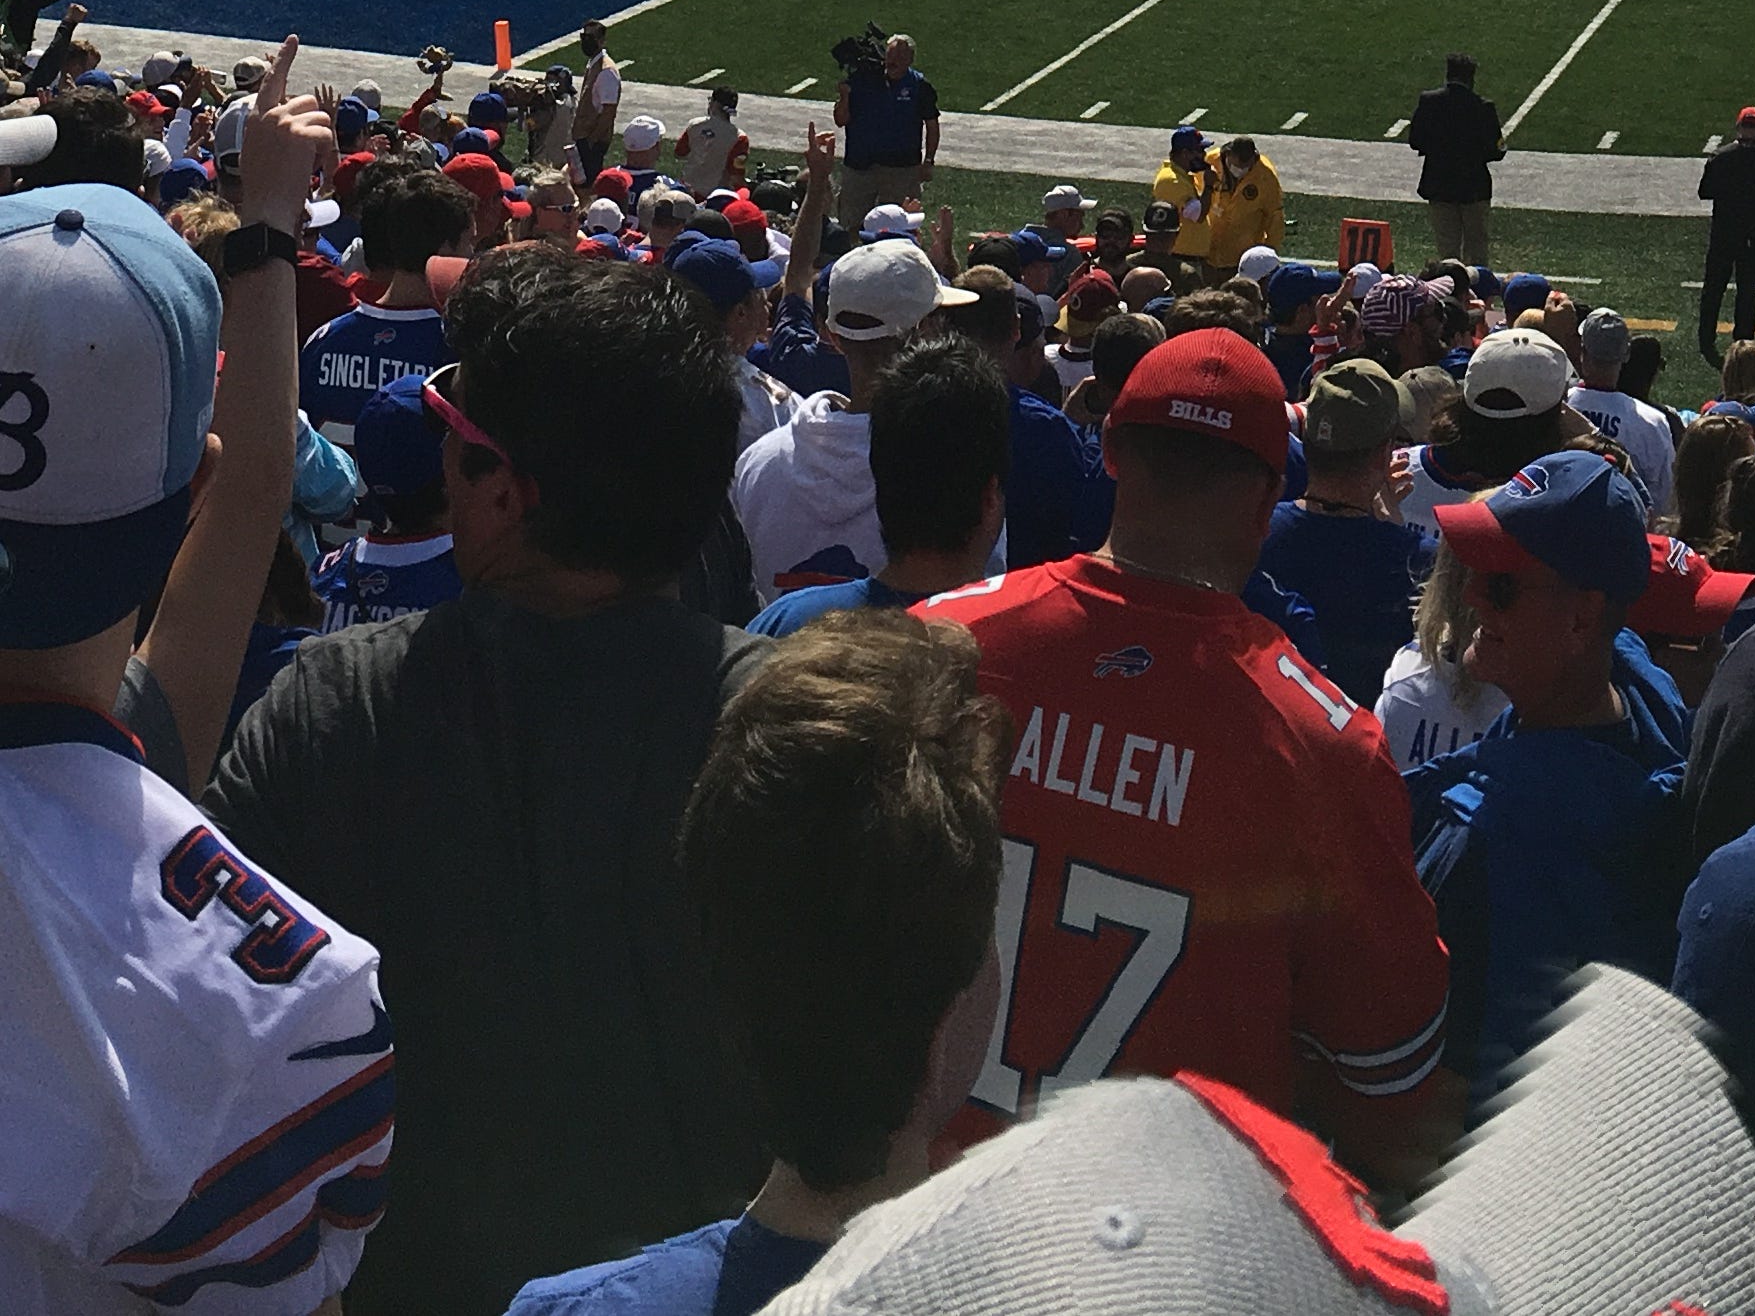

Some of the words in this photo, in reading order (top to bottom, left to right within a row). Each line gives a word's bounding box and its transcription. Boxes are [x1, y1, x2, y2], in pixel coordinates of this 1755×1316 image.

[1348, 227, 1381, 264] 10
[1167, 399, 1233, 430] BILLS
[1009, 705, 1196, 828] ALLEN
[969, 836, 1193, 1118] 17
